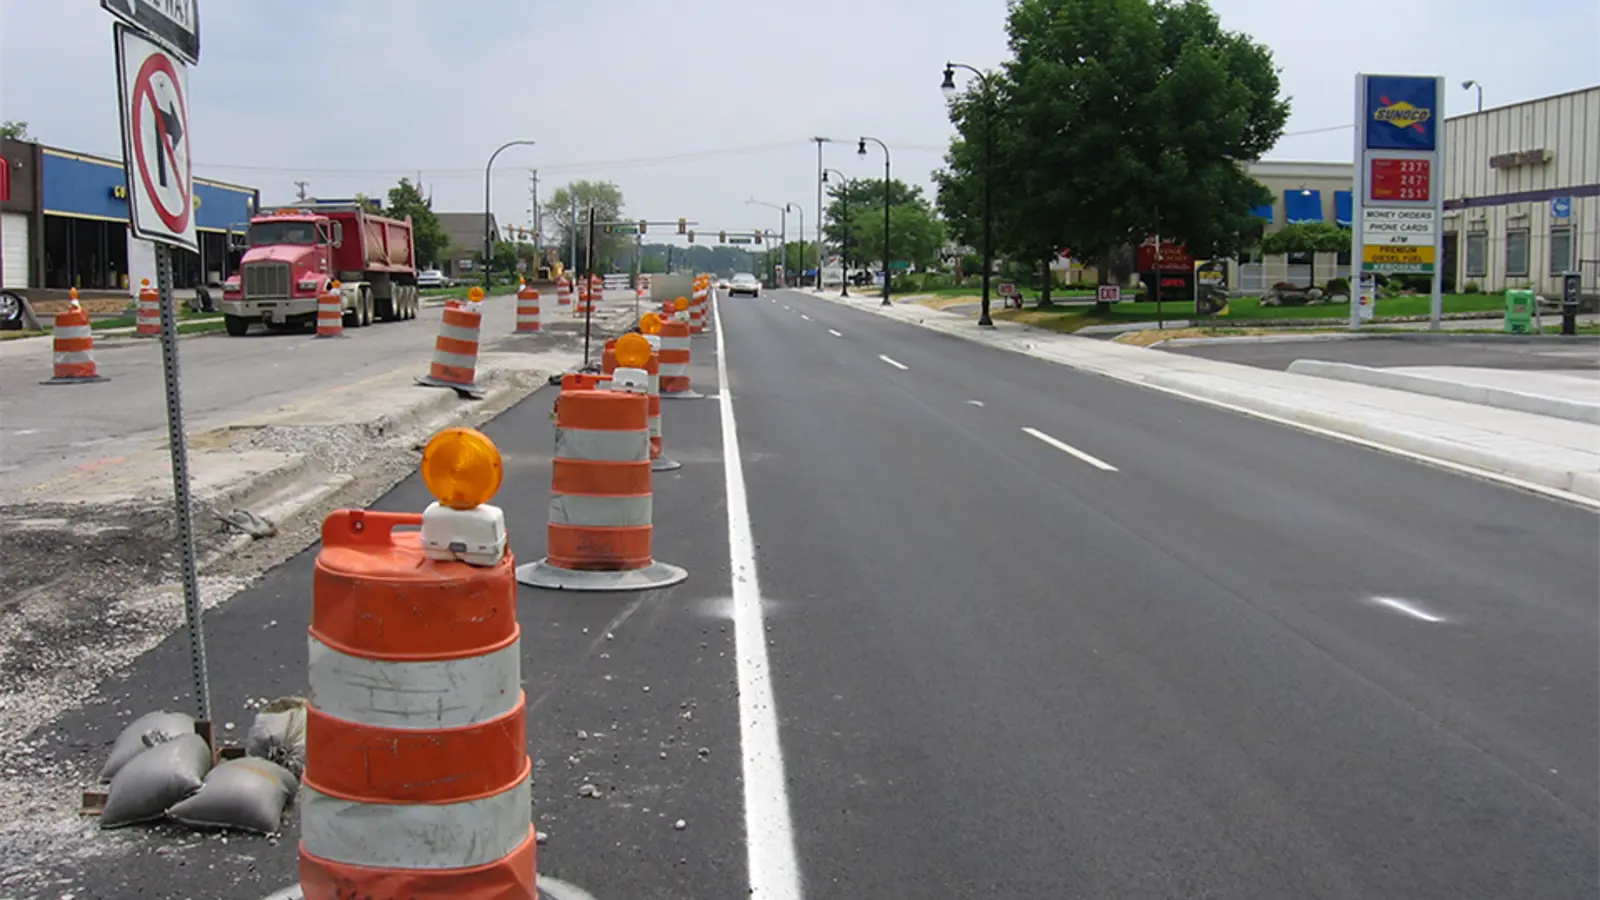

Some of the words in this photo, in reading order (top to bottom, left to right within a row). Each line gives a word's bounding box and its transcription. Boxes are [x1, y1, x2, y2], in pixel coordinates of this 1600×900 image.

[1376, 109, 1428, 121] SUNOCO
[1366, 210, 1395, 218] MONEY
[1397, 211, 1432, 219] ORDERS
[1369, 223, 1398, 231] PHONE
